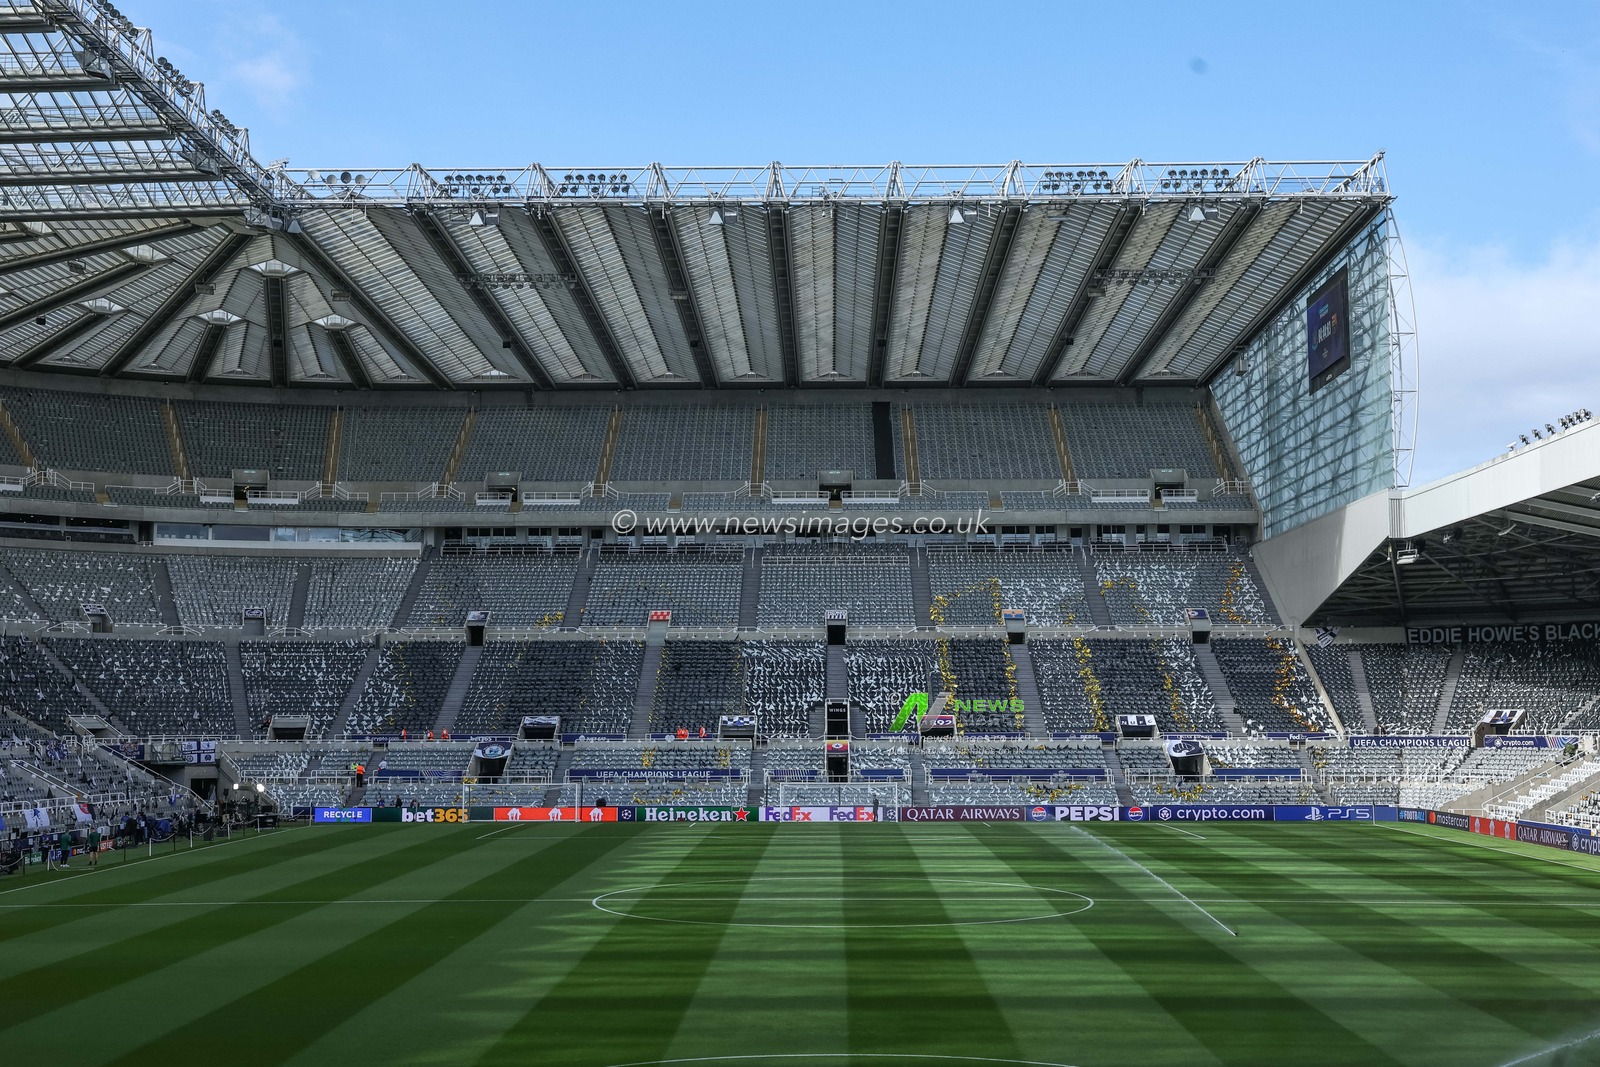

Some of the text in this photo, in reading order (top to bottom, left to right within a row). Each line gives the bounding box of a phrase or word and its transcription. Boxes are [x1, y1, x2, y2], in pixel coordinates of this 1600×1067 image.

[1407, 628, 1462, 644] EDDIE
[1468, 625, 1540, 642] HOWE'S
[324, 811, 362, 819] RECYCLE
[402, 808, 469, 823] bet365
[645, 807, 732, 821] Heineken
[765, 806, 812, 821] FedEx
[829, 806, 874, 821] FedEx
[906, 808, 1020, 821] QATAR AIRWAYS
[1055, 807, 1119, 821] PEPSI
[1177, 807, 1265, 821] crypto.com
[1327, 808, 1370, 819] PS5
[1399, 810, 1425, 821] #FOOTBALL
[1437, 813, 1469, 828] mastercard
[1518, 826, 1567, 845] QATAR AIRWAYS
